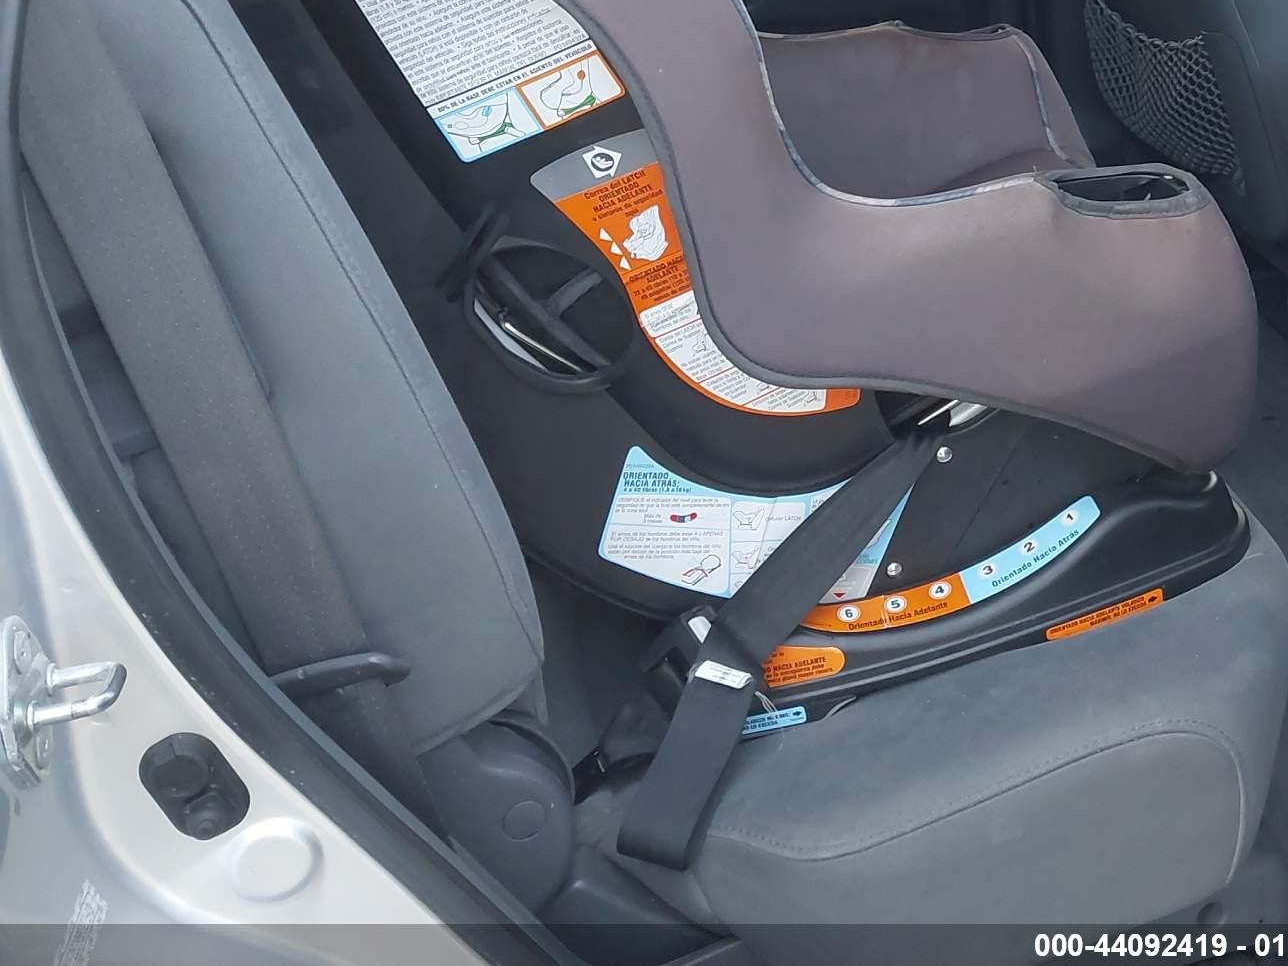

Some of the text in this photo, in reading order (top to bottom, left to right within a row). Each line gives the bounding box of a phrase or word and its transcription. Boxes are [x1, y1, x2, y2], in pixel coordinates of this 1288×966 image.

[582, 170, 647, 199] Correa del LATCH
[595, 181, 642, 202] ORIENTADO
[591, 184, 654, 212] HACIA ADELANTE
[622, 469, 669, 481] ORIENTADO
[623, 478, 650, 488] HACIA
[1066, 512, 1075, 522] 1
[1024, 542, 1036, 553] 2
[990, 527, 1081, 589] Orientado Hacia Atrás
[982, 565, 994, 576] 3
[934, 585, 945, 595] 4
[890, 599, 901, 609] 5
[844, 608, 854, 619] 6
[888, 610, 912, 622] Hacia
[912, 600, 948, 616] Adelante
[793, 656, 826, 667] ADELANTE
